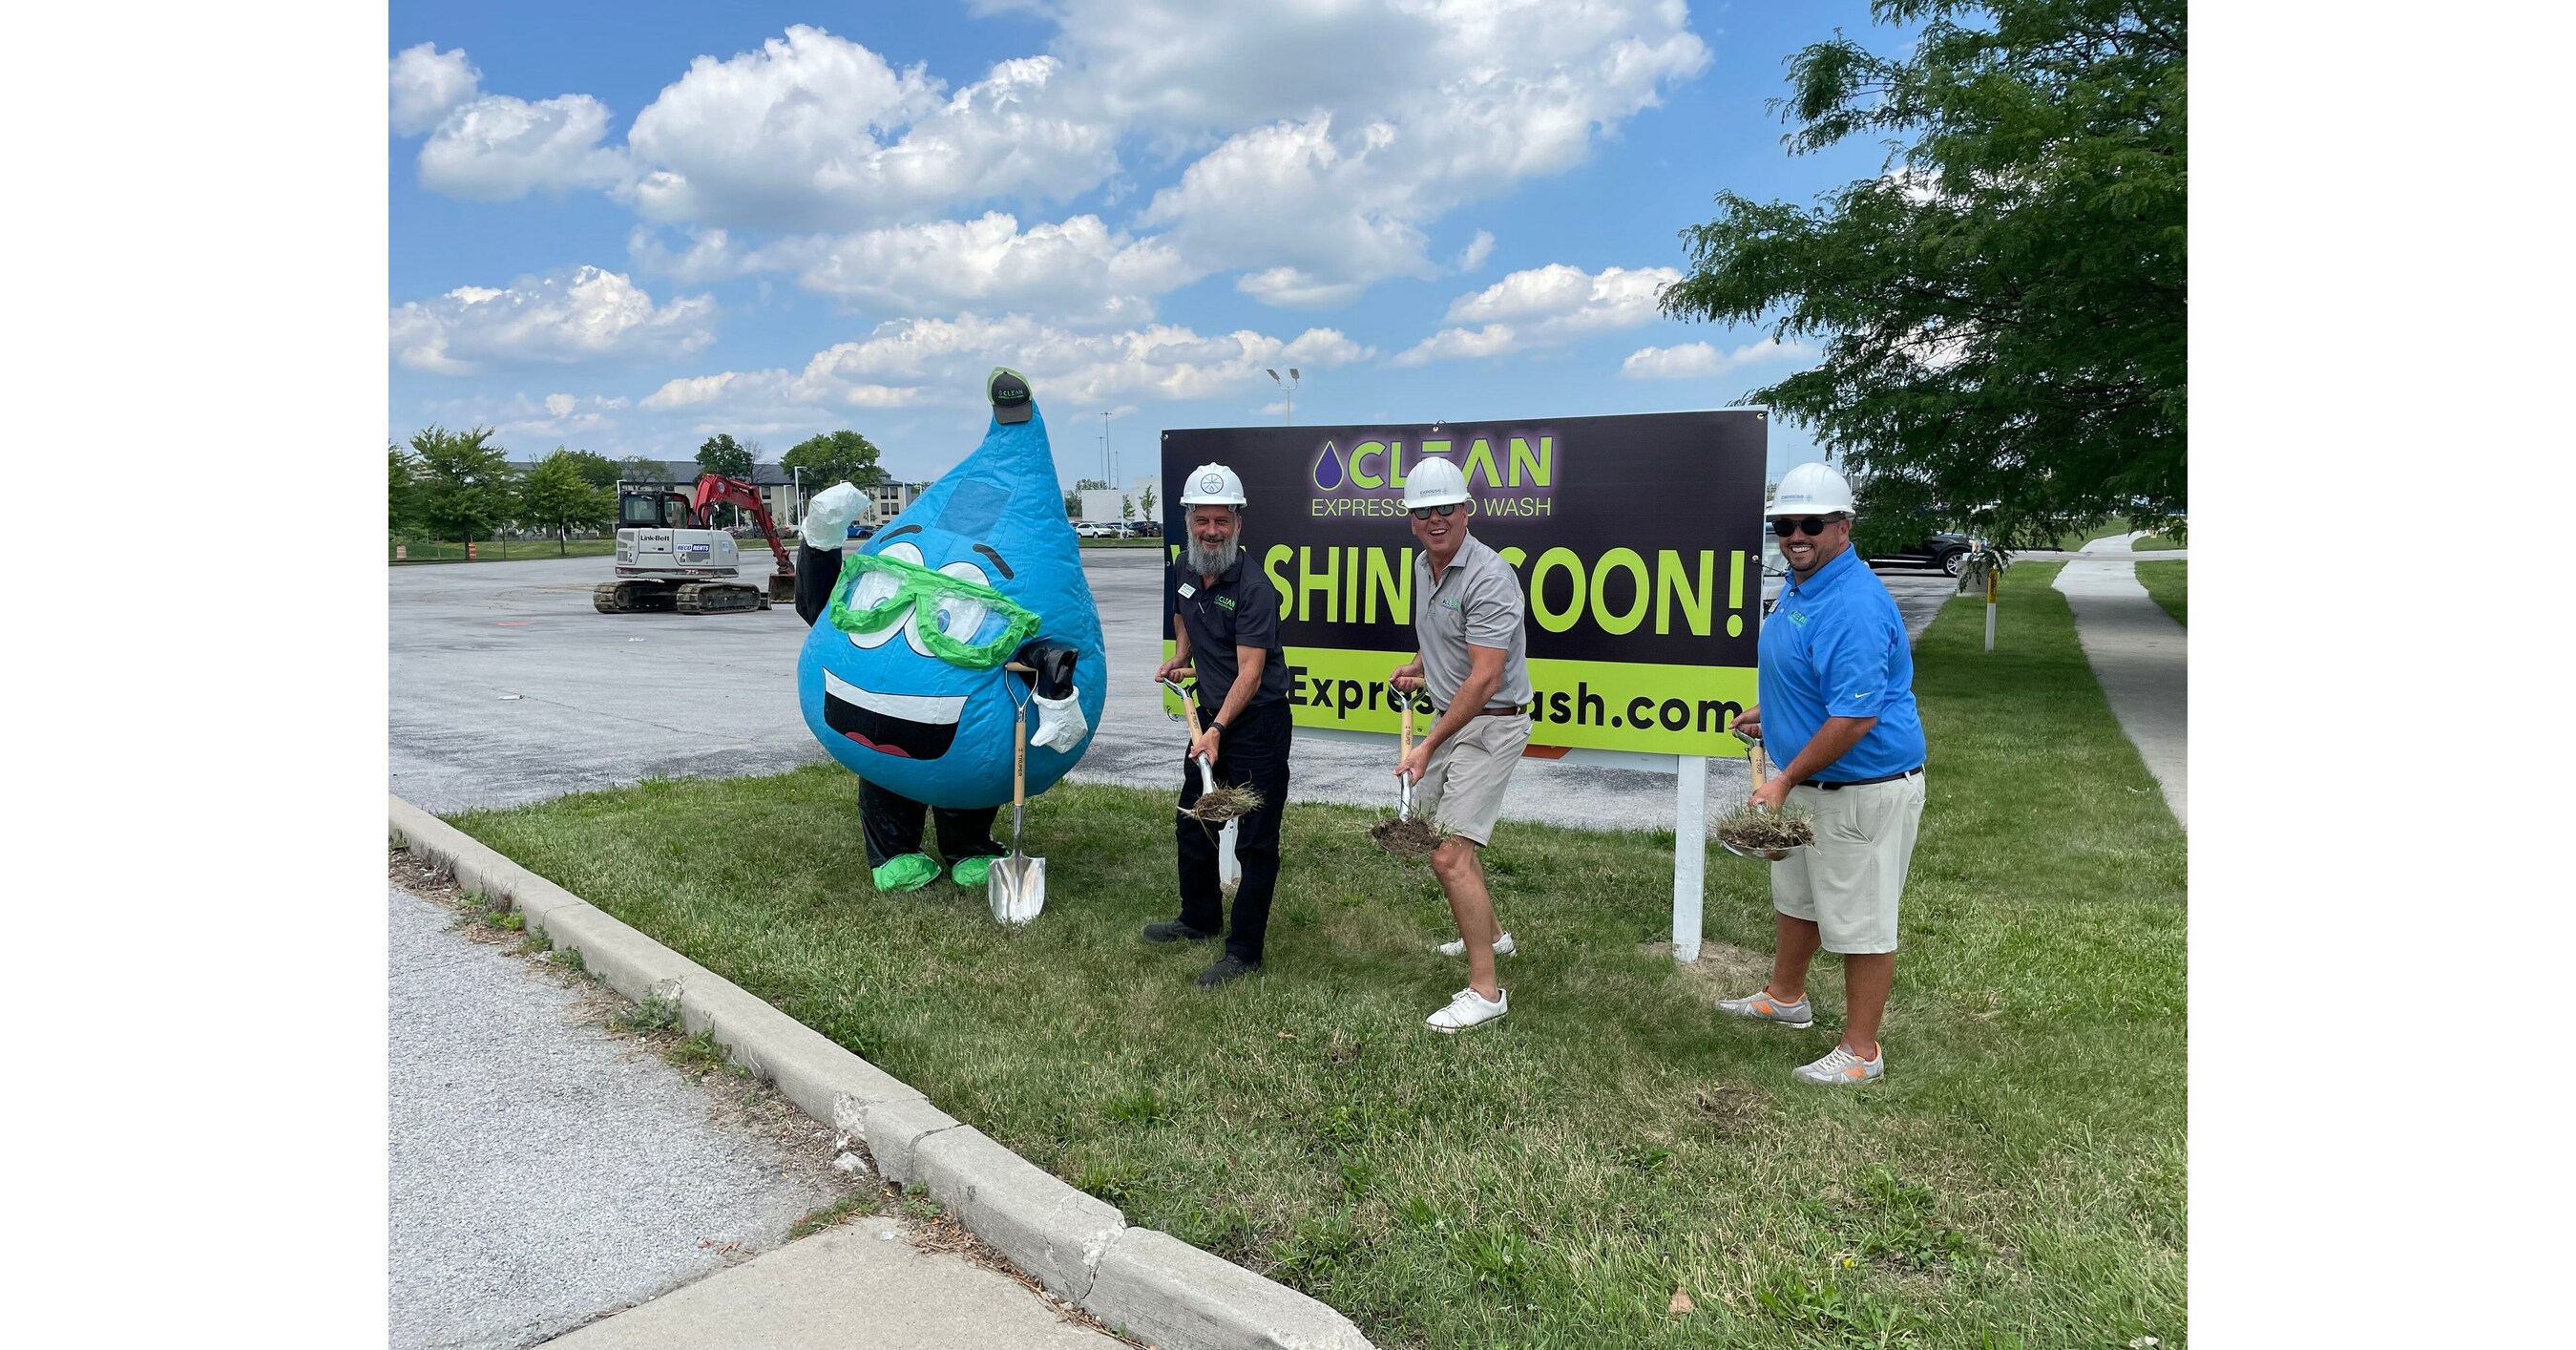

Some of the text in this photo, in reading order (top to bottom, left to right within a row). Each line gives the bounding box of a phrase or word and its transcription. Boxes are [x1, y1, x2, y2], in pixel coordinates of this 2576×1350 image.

[1311, 498, 1409, 517] EXPRESS
[1483, 496, 1551, 517] WASH
[1170, 543, 1414, 625] SHIN
[1219, 596, 1236, 608] CLEAN
